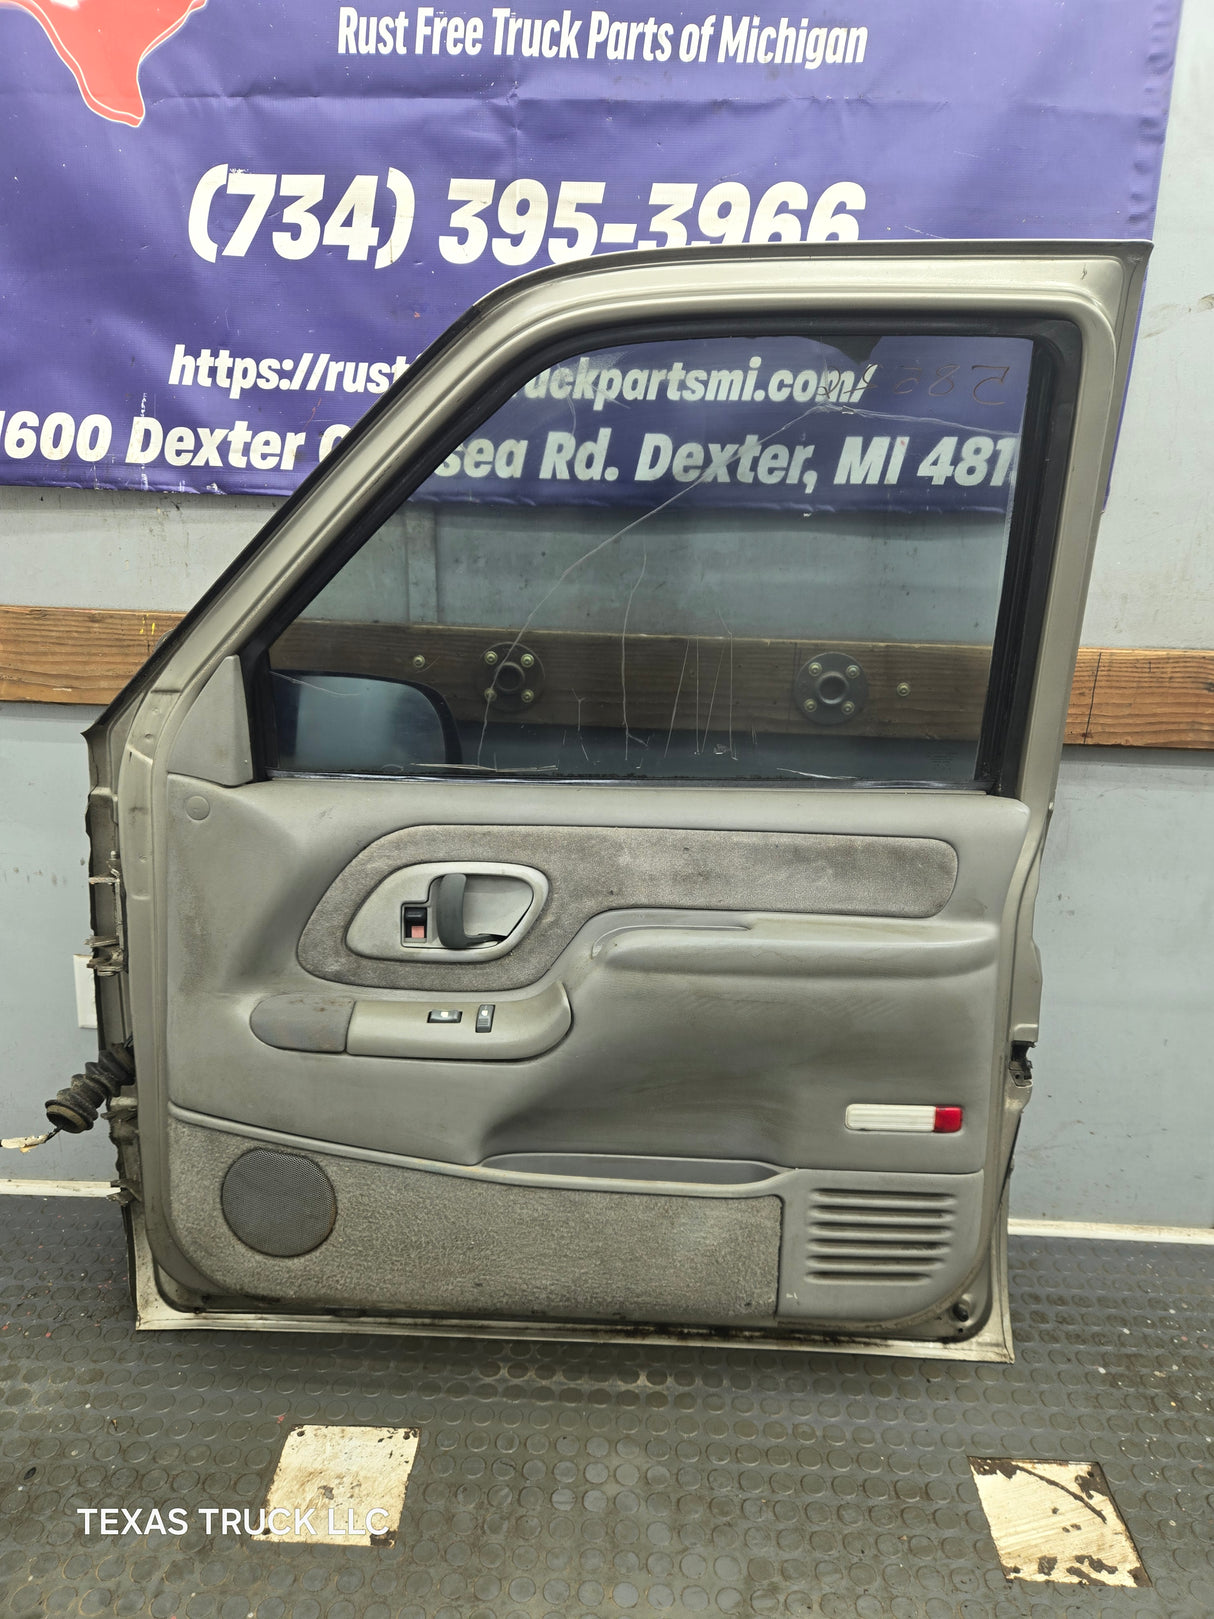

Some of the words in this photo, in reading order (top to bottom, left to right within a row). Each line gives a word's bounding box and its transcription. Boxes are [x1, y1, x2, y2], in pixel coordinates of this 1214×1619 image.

[337, 7, 409, 55] Rust
[415, 7, 484, 55] Free
[492, 8, 583, 59] Truck
[586, 10, 675, 62] Parts
[678, 14, 716, 63] of
[717, 15, 868, 70] Michigan
[188, 164, 416, 270] (734)
[438, 178, 867, 266] 395-3966
[125, 416, 306, 471] Dexter
[539, 427, 619, 481] Rd.
[634, 433, 818, 494] Dexter,
[833, 436, 910, 485] MI
[916, 436, 1019, 487] 481
